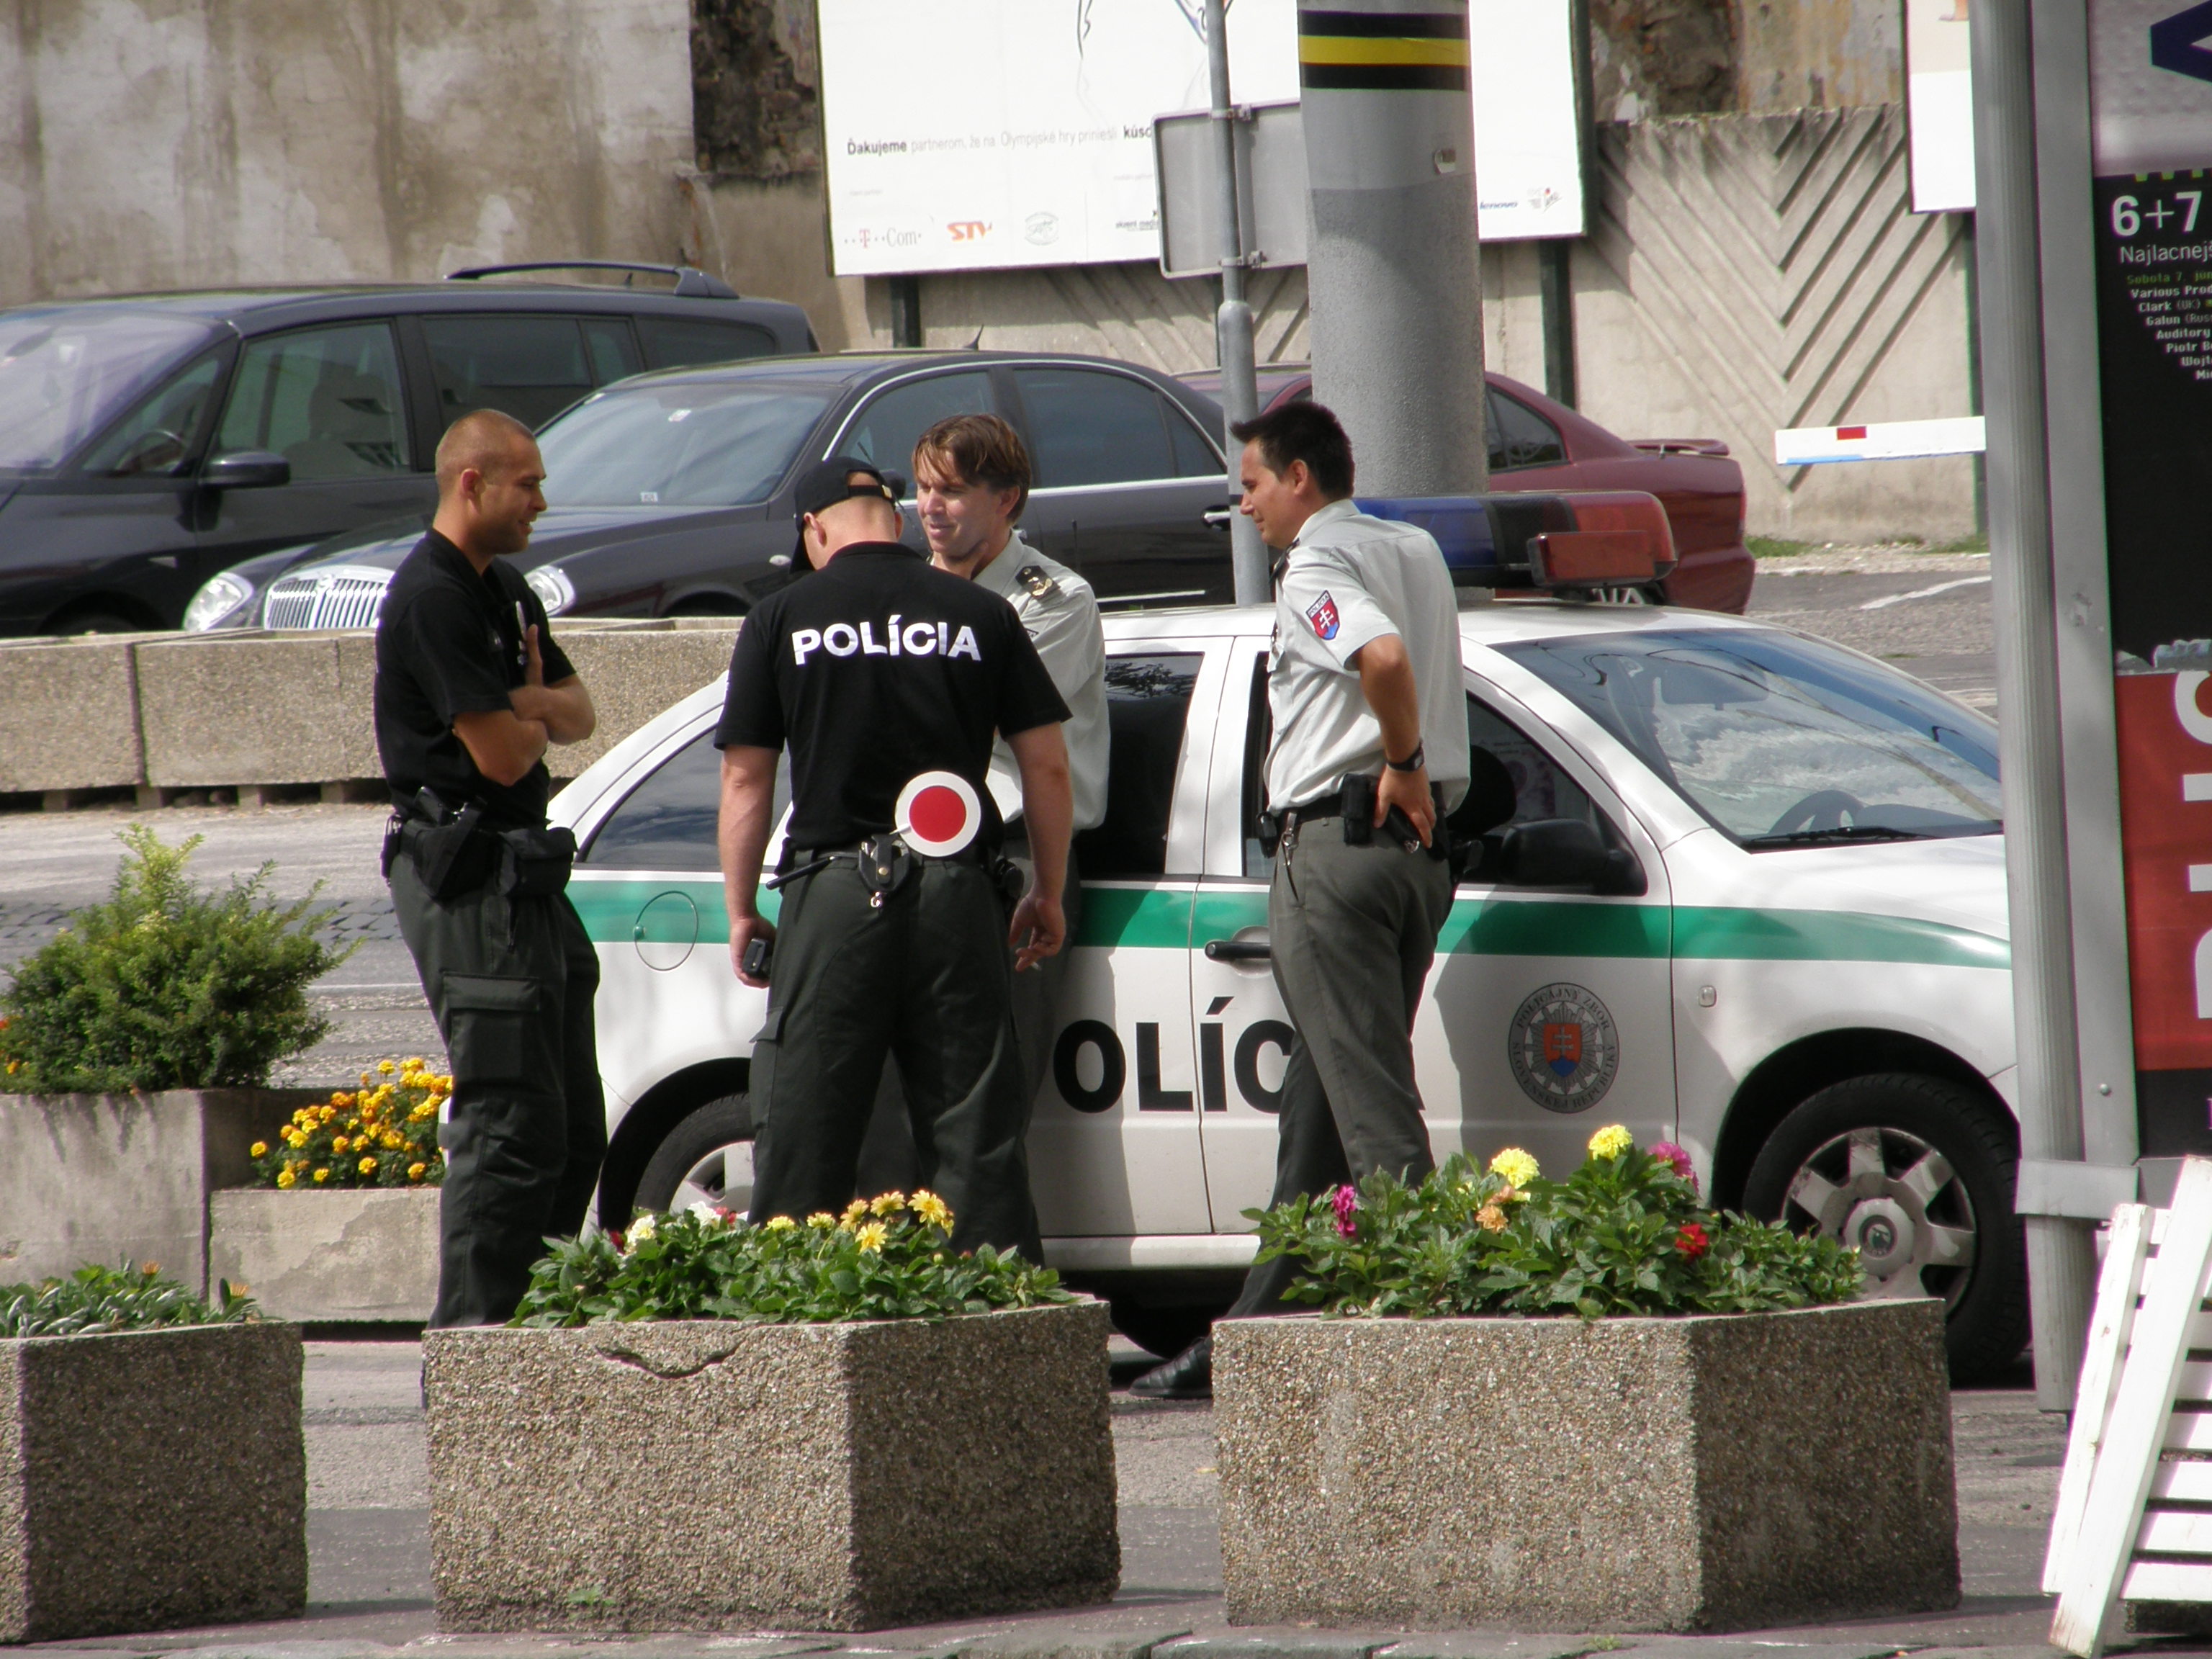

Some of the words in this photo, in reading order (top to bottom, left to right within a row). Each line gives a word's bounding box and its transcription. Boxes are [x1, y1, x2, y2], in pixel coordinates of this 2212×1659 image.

[848, 137, 907, 156] Ďakujeme
[984, 136, 995, 148] na
[1058, 129, 1076, 145] hry
[2113, 191, 2202, 236] 6+7
[2127, 273, 2170, 284] Sobota
[2131, 287, 2180, 299] Various
[2139, 300, 2172, 312] Clark
[2185, 313, 2212, 324] (Rus
[2156, 328, 2211, 340] Auditory
[2166, 342, 2197, 353] Piotr
[2202, 341, 2212, 351] B
[2181, 355, 2212, 367] Wojt
[792, 614, 981, 665] POLÍCIA
[1583, 996, 1610, 1030] ZBOR
